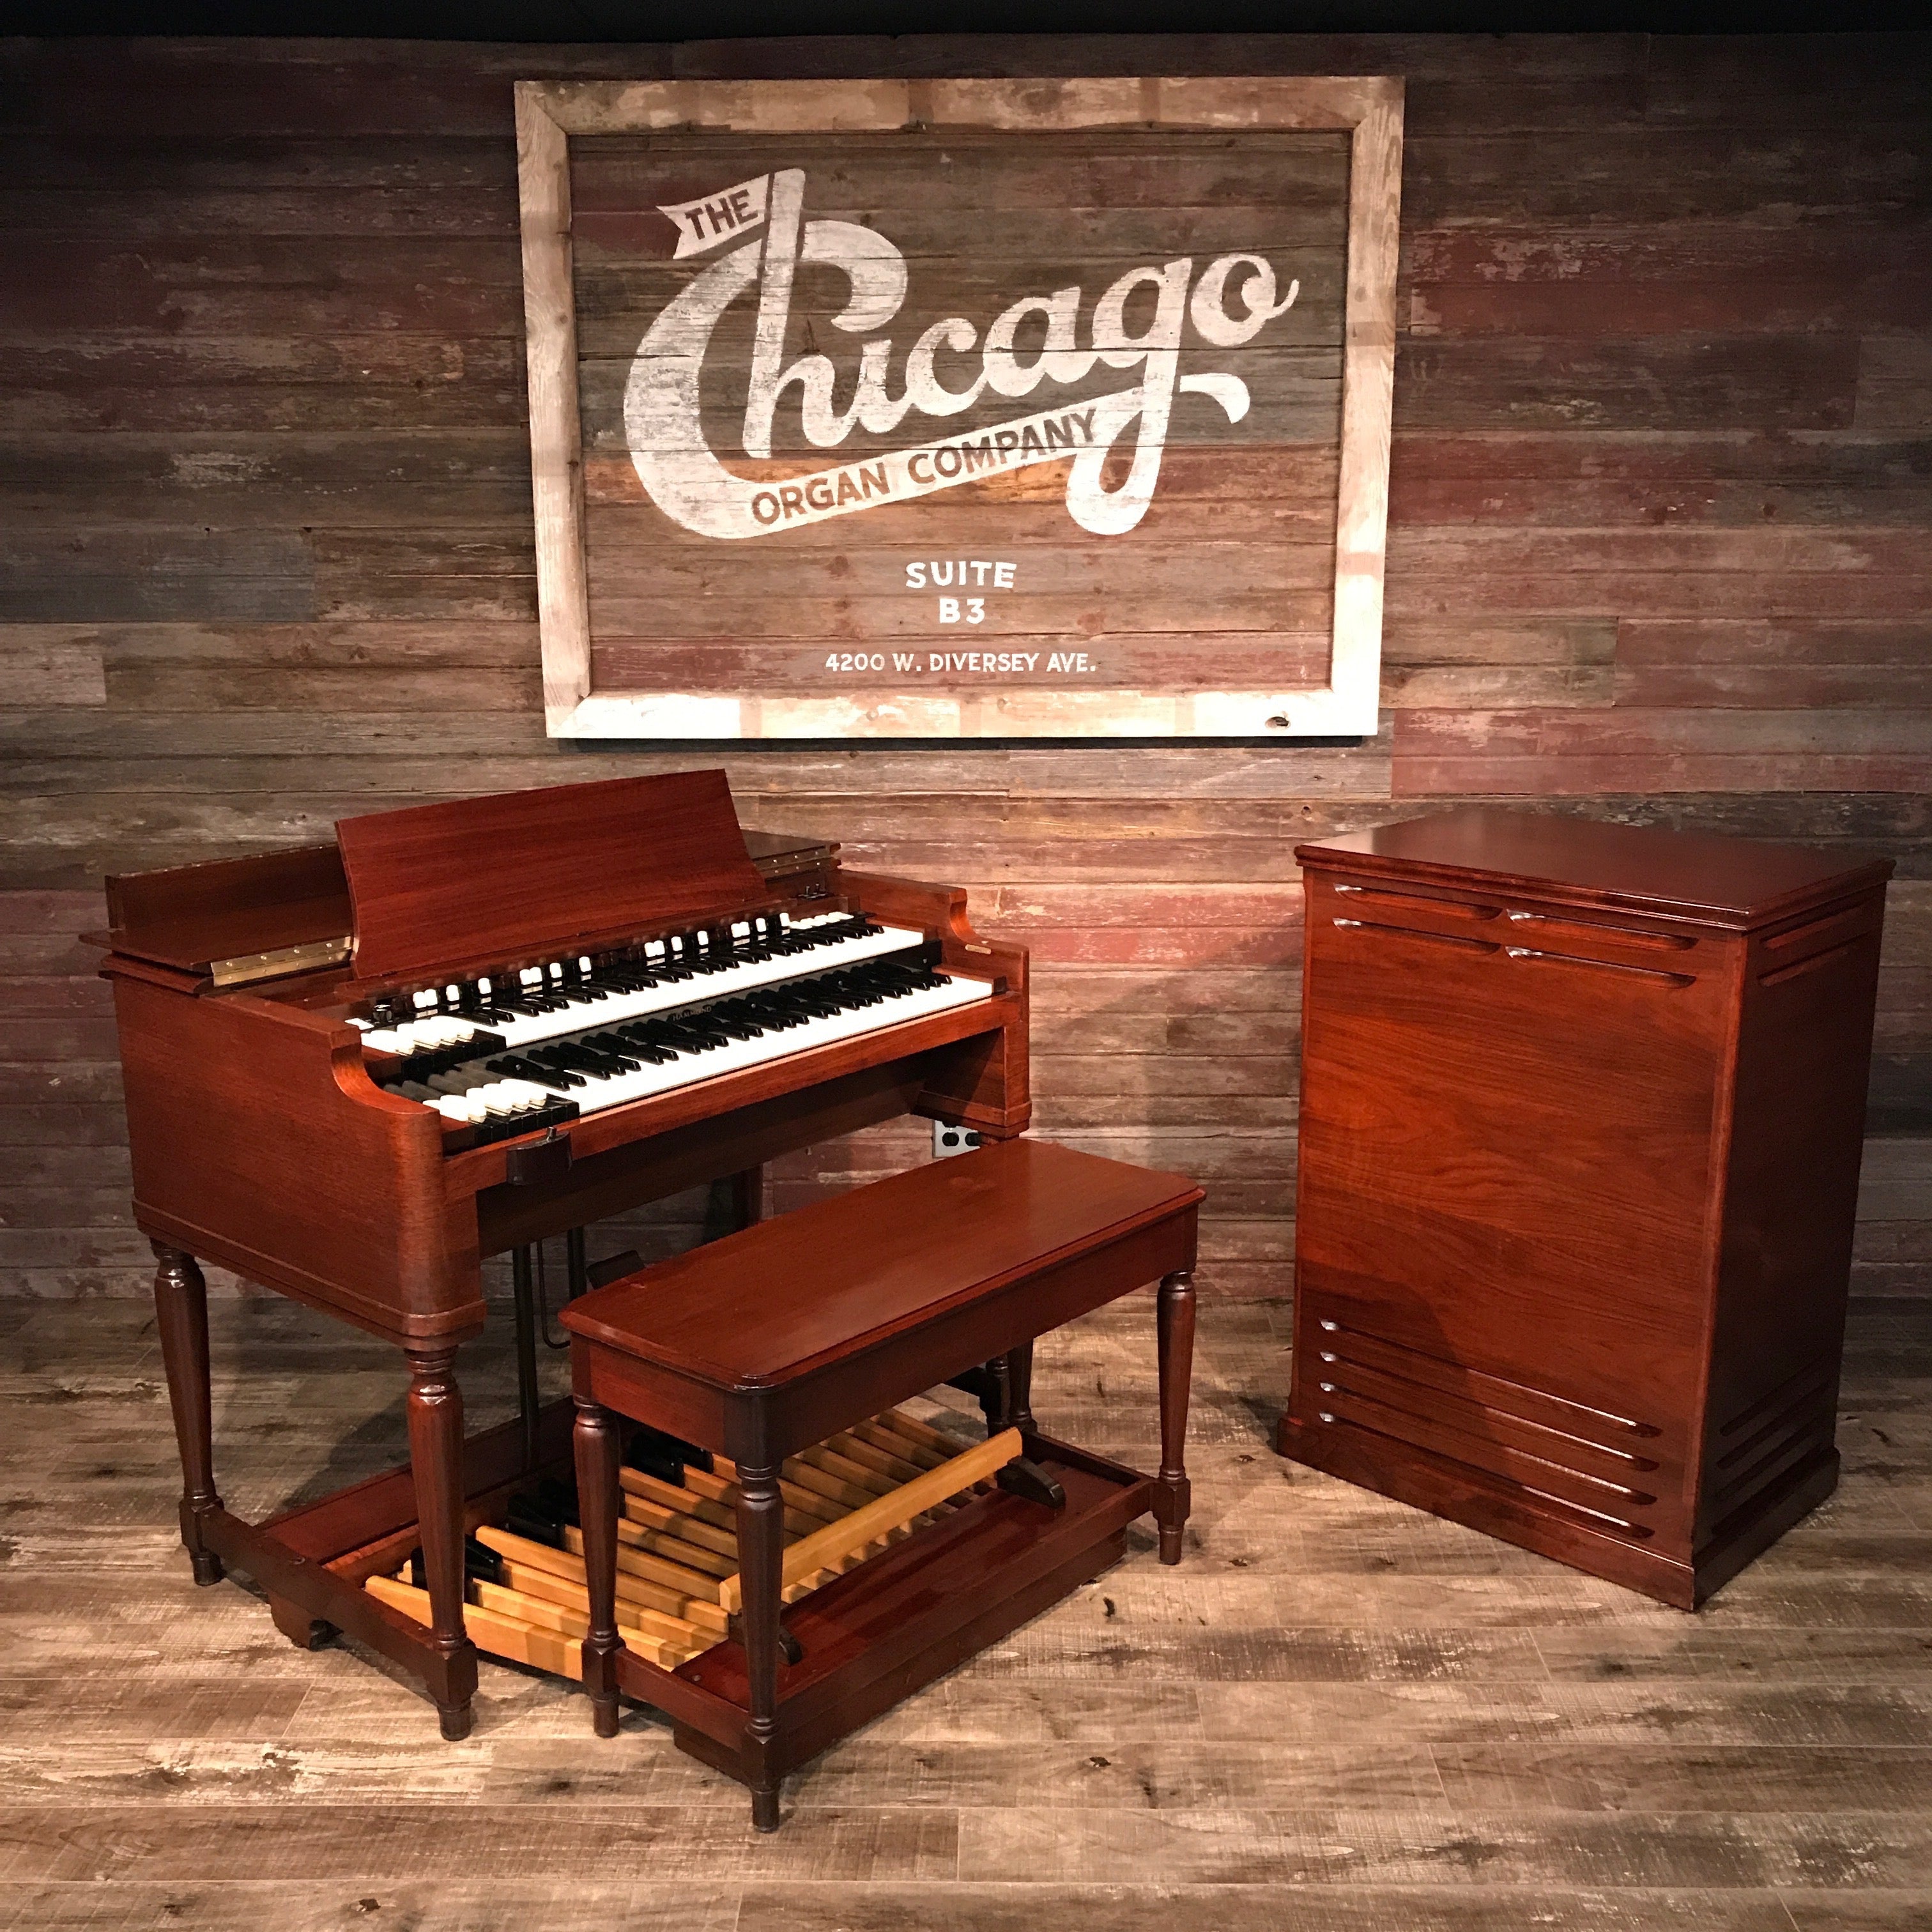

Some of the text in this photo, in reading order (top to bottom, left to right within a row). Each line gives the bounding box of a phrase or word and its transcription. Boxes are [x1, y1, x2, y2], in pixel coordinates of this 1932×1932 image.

[685, 189, 758, 240] THE
[624, 168, 1300, 539] Chicago
[752, 408, 1096, 525] ORGAN COMPANY
[906, 561, 1017, 588] SUITE
[939, 598, 985, 624] B3
[825, 653, 1096, 672] 4200 W. DIVERSEY AVE.
